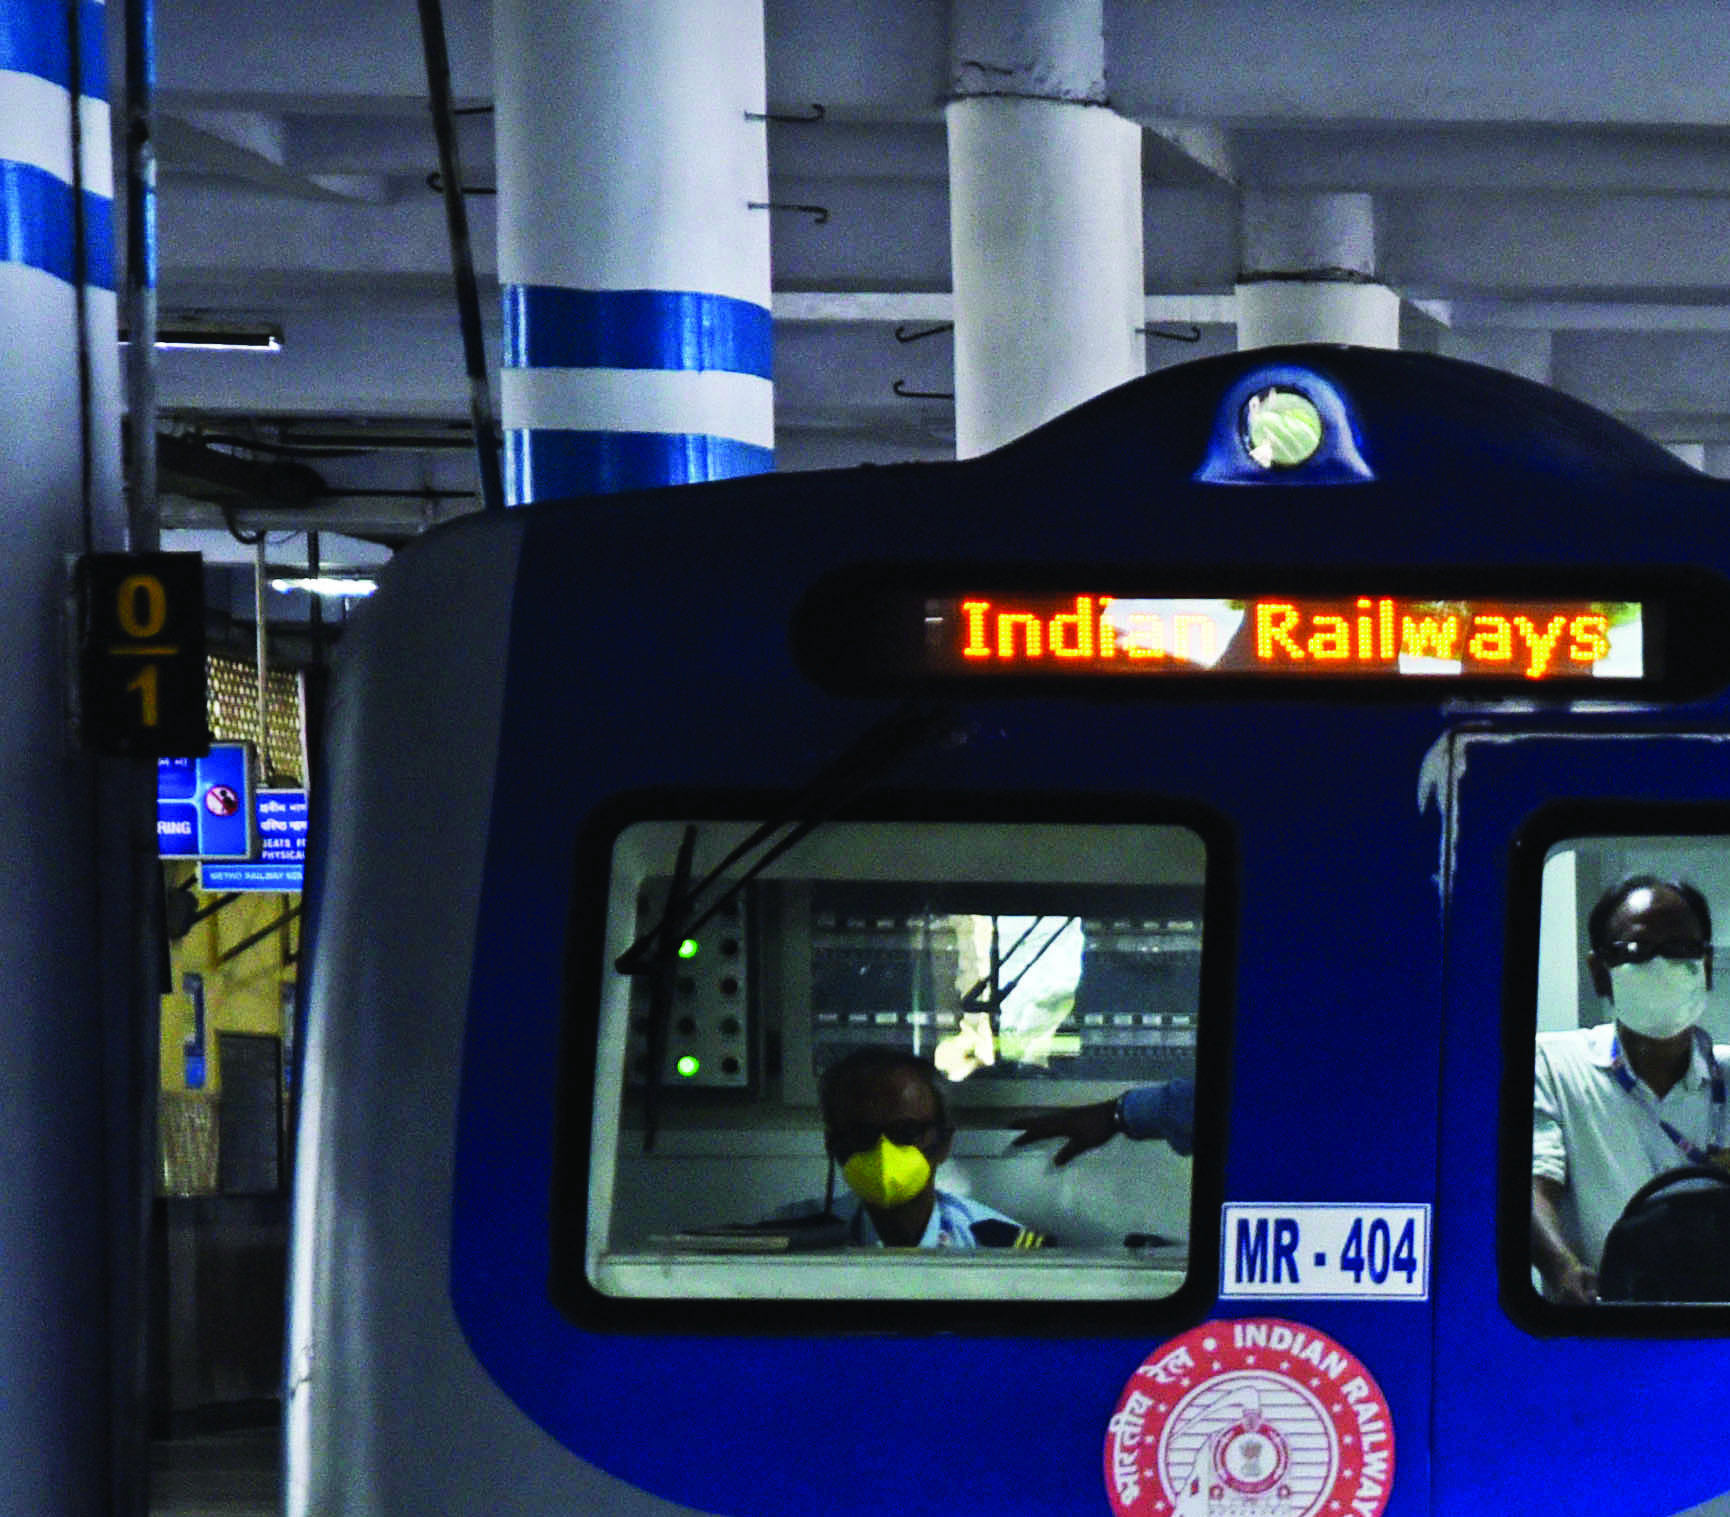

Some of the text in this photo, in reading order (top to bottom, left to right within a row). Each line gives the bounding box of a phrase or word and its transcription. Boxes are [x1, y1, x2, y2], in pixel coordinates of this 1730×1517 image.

[118, 574, 166, 637] 0
[962, 595, 1609, 677] Indian Railways
[128, 664, 157, 727] 1
[157, 821, 191, 835] RING
[1235, 1217, 1300, 1284] MR
[1340, 1217, 1417, 1284] 404
[1232, 1323, 1348, 1380] INDIAN
[1109, 1346, 1195, 1505] भारतीय रेल
